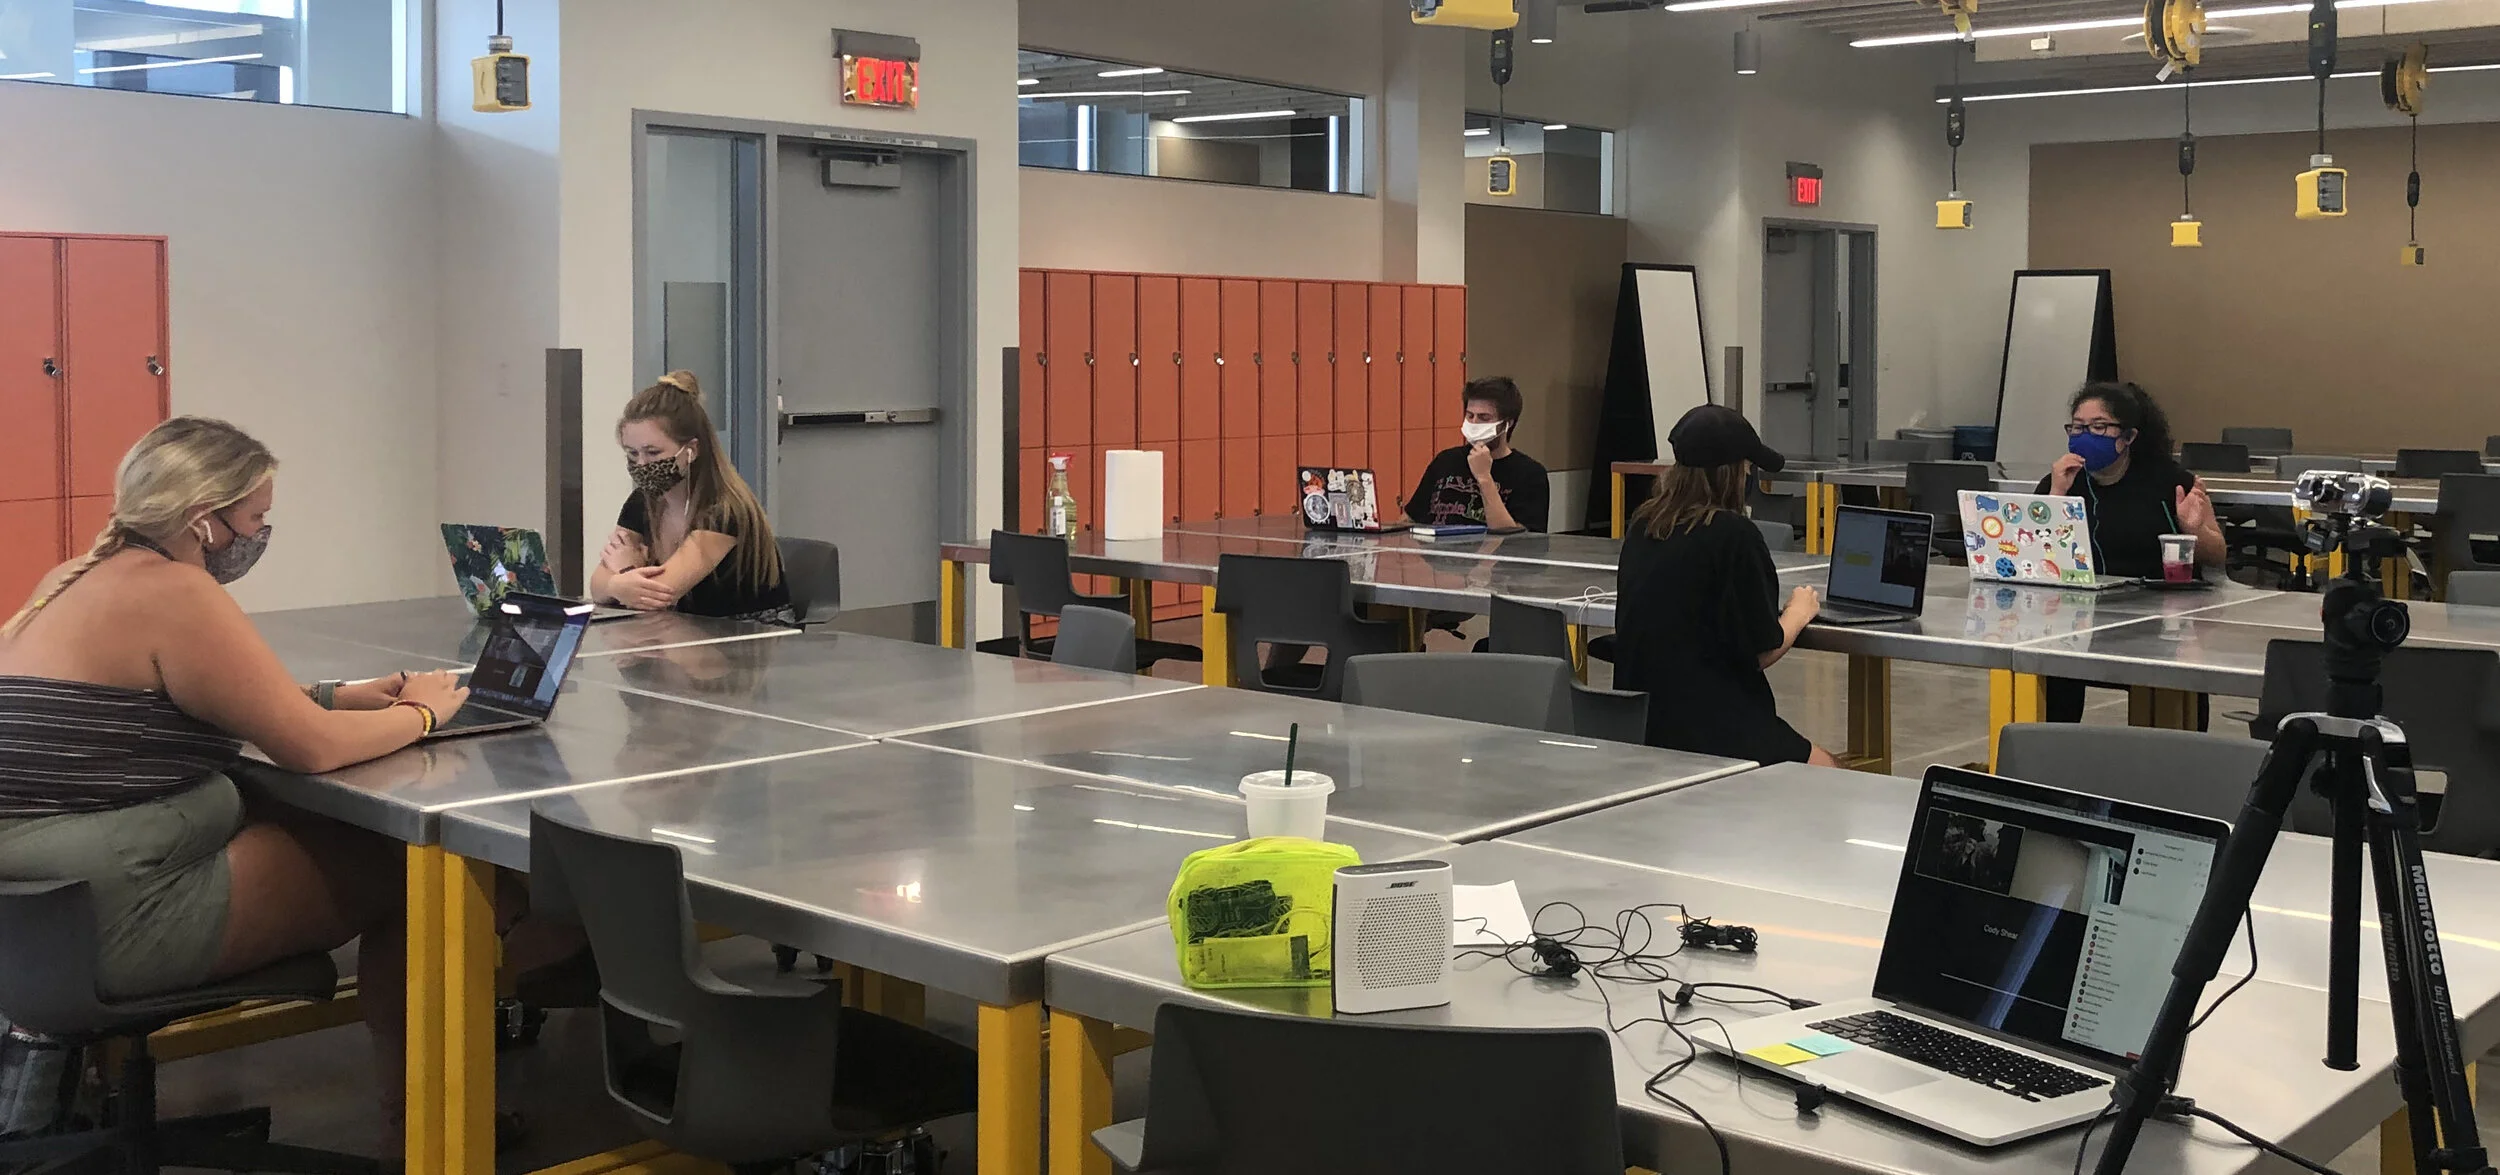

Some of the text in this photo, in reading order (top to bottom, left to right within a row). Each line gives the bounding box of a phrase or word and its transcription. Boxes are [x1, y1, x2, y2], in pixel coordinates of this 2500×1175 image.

[857, 57, 906, 103] EXIT
[1797, 177, 1817, 203] EXIT
[1385, 880, 1418, 889] BOSE
[1983, 924, 2000, 936] Cody
[2411, 864, 2442, 976] Manfrotto
[2382, 912, 2400, 982] Manfrotto
